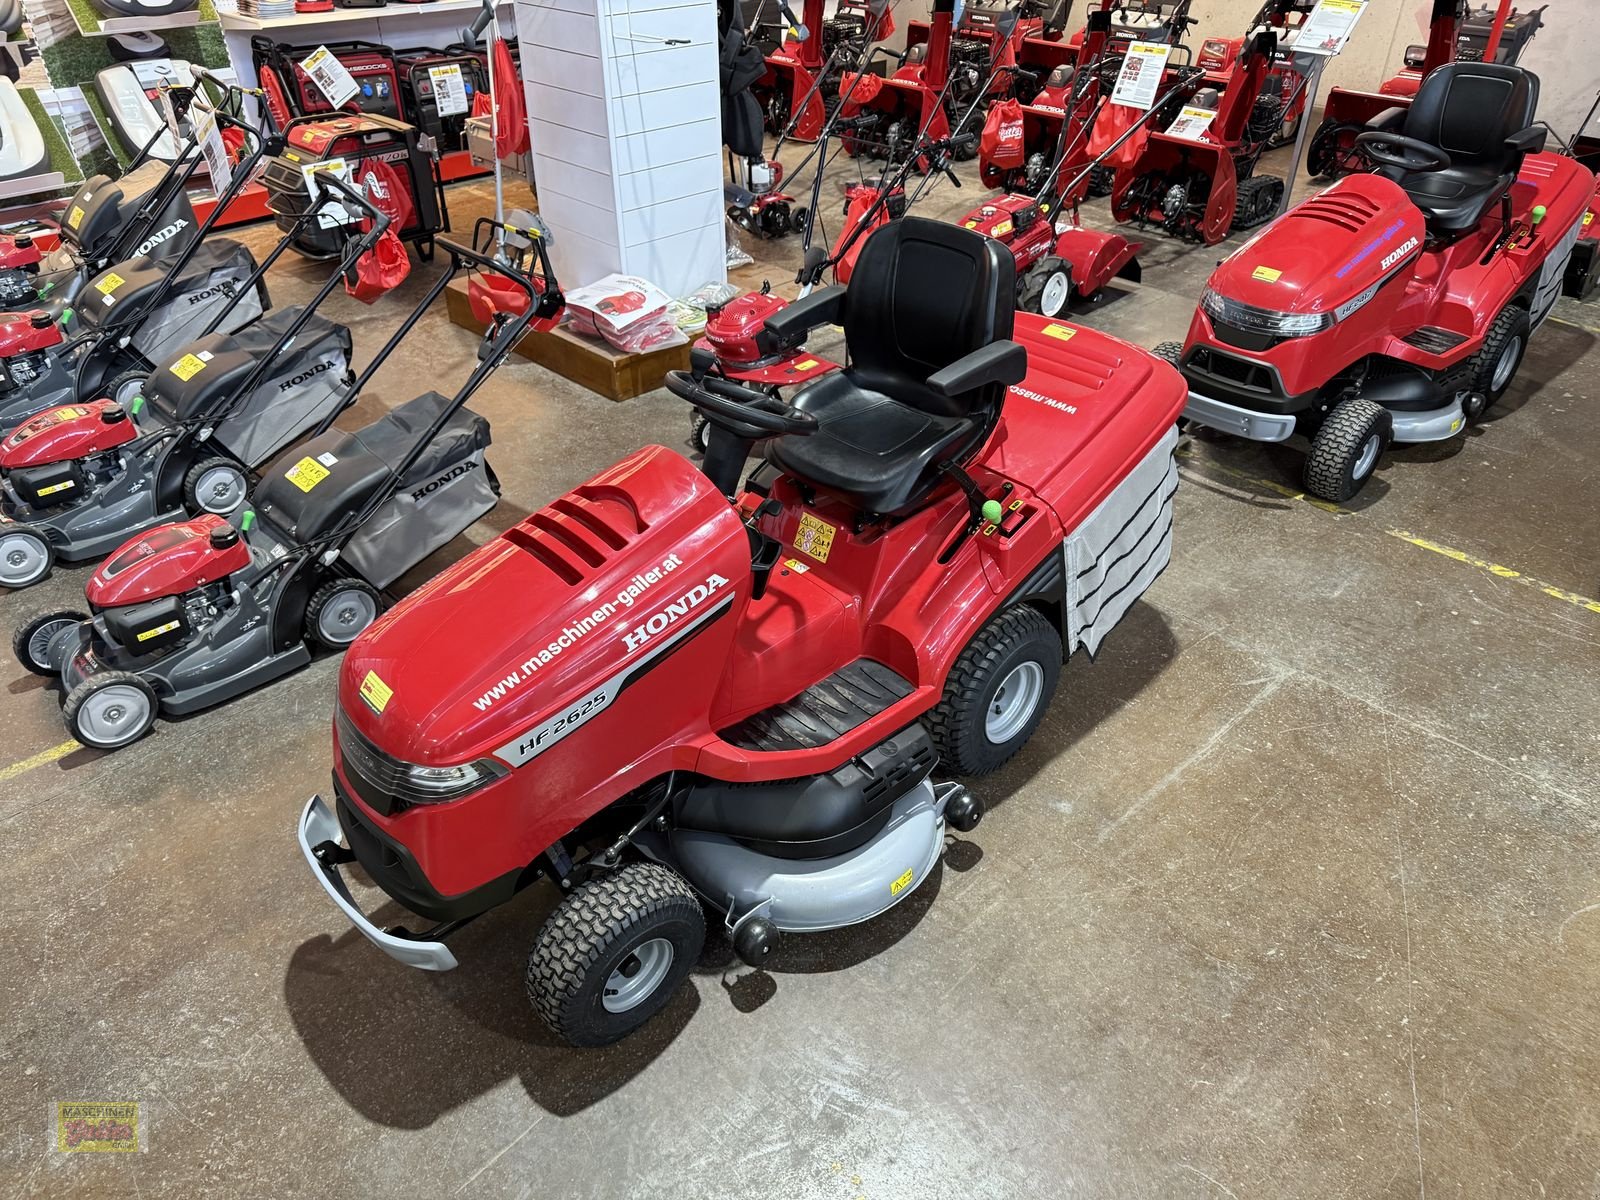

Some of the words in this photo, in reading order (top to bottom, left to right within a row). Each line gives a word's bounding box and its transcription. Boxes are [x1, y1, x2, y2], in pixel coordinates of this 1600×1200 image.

[971, 14, 991, 22] HONDA
[1115, 31, 1138, 40] HONDA
[1380, 236, 1419, 271] HONDA
[278, 360, 337, 393] HONDA
[1008, 384, 1078, 415] www.masc
[411, 460, 480, 503] HONDA
[620, 573, 730, 653] HONDA
[471, 551, 684, 712] www.maschinen-gailer.at
[519, 728, 550, 757] HF
[553, 690, 606, 735] 2625
